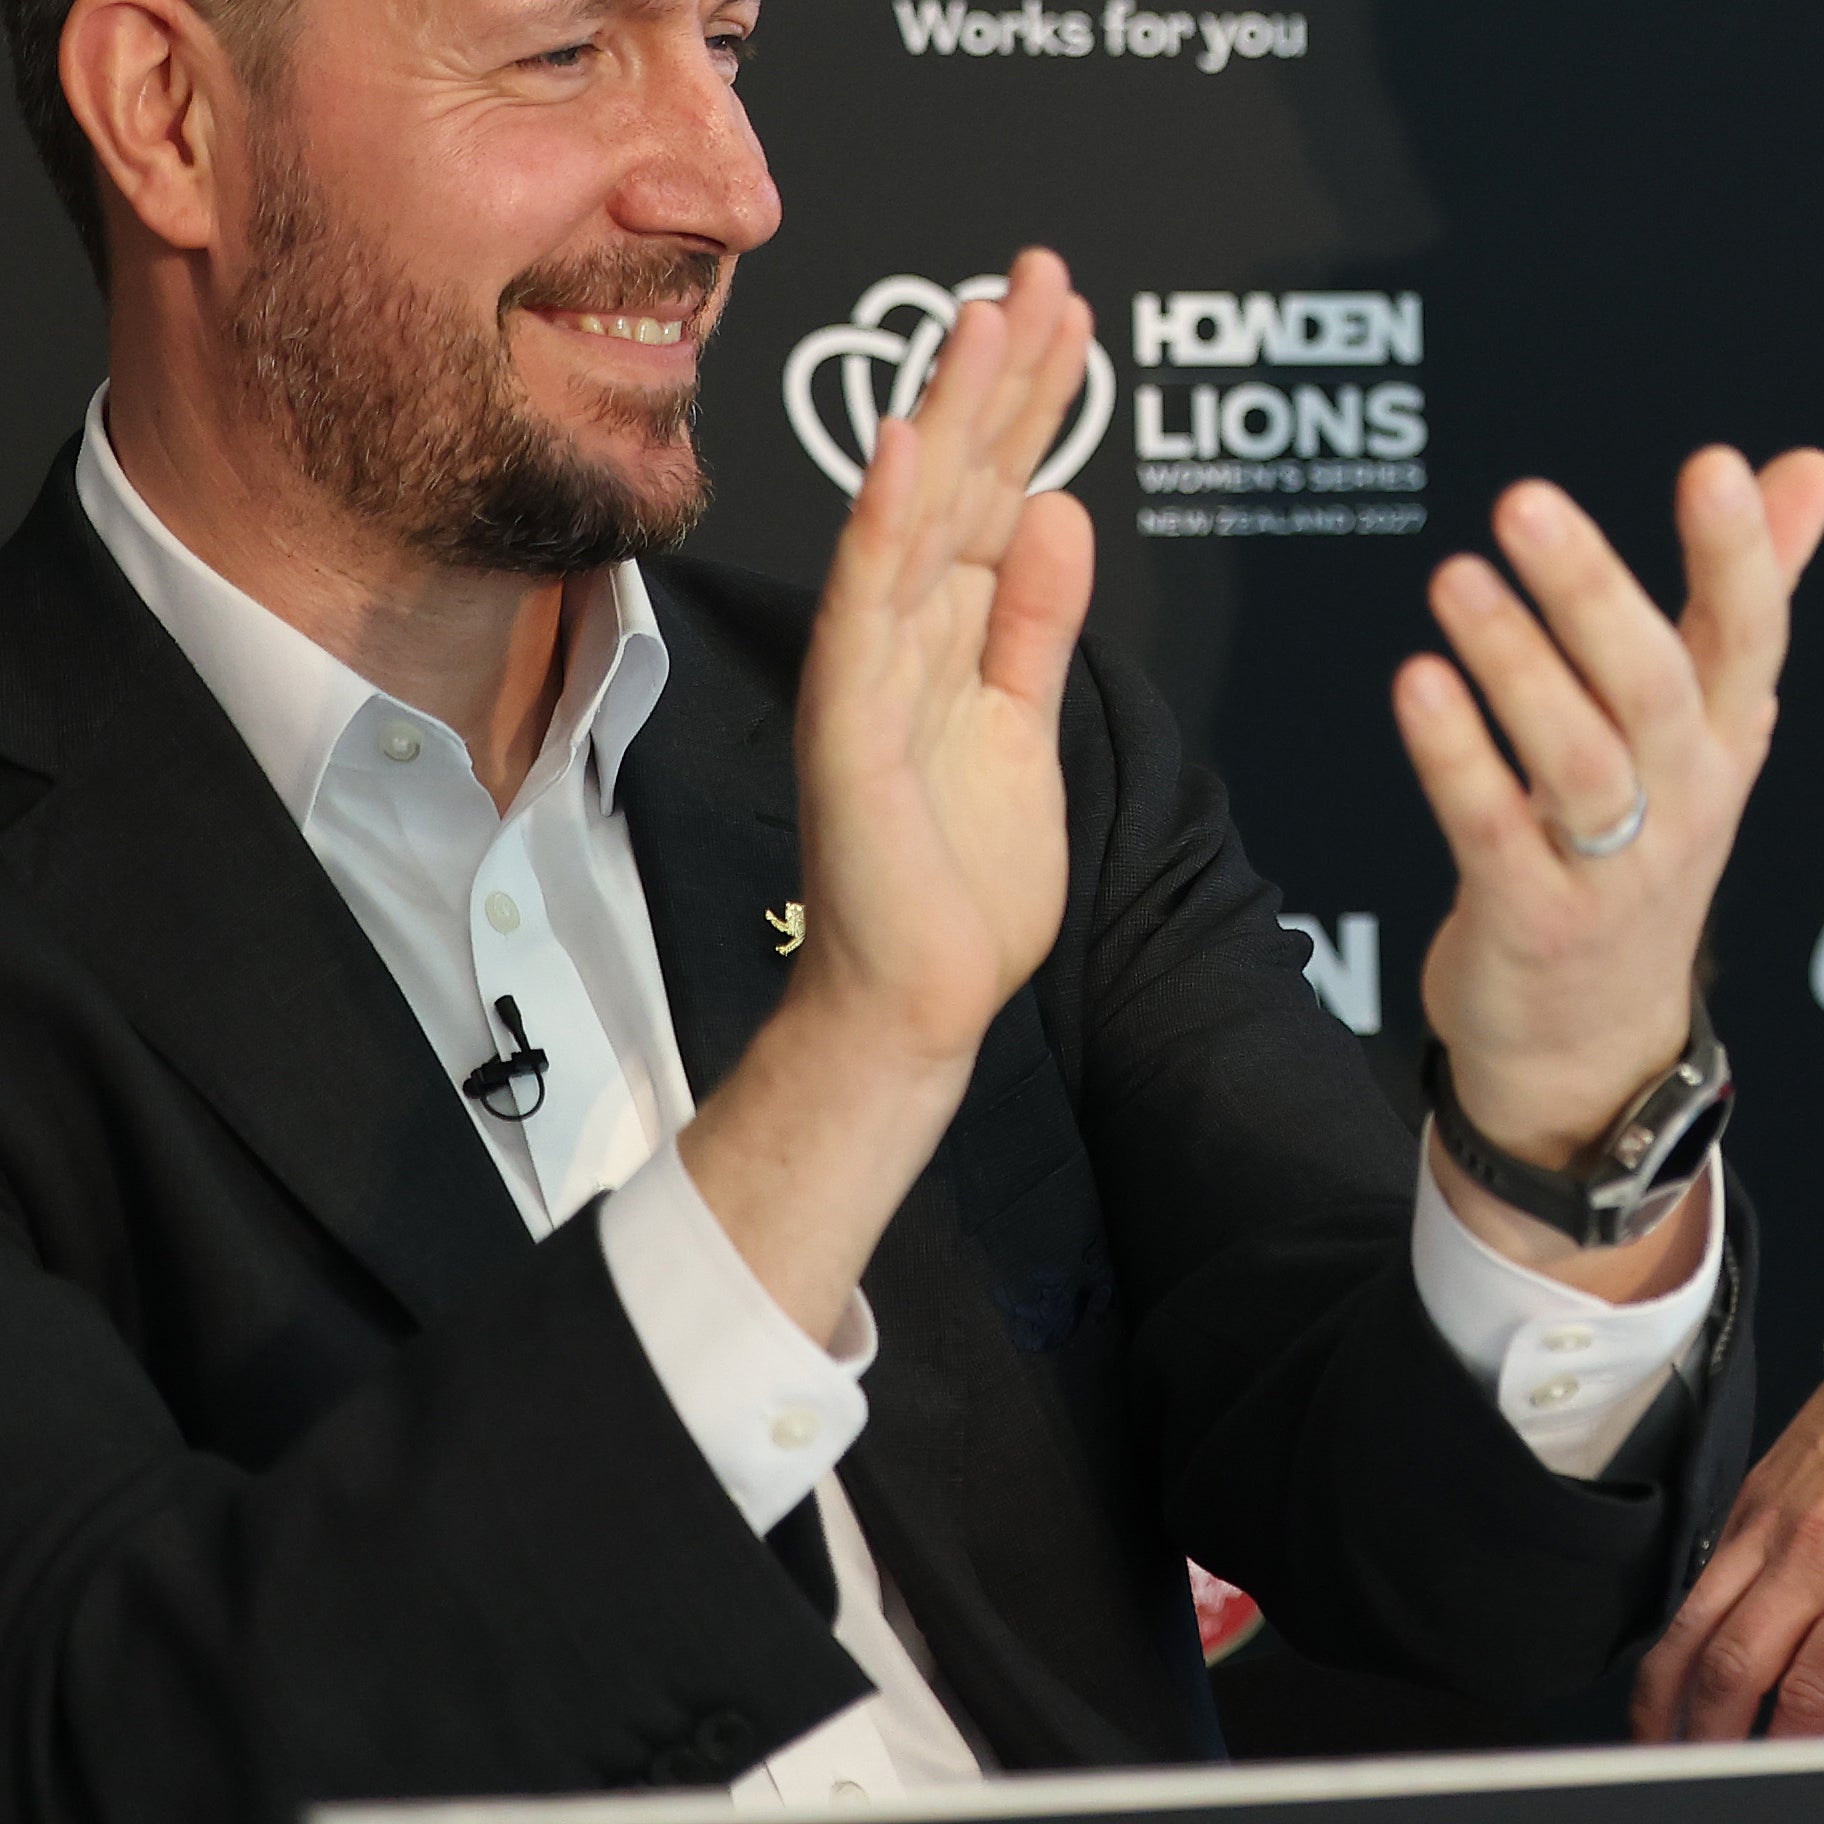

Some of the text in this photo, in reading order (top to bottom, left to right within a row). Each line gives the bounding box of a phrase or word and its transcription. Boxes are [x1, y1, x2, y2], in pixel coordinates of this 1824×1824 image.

[1196, 10, 1308, 74] you
[1131, 290, 1424, 367] HOWDEN
[1135, 380, 1429, 461] LIONS
